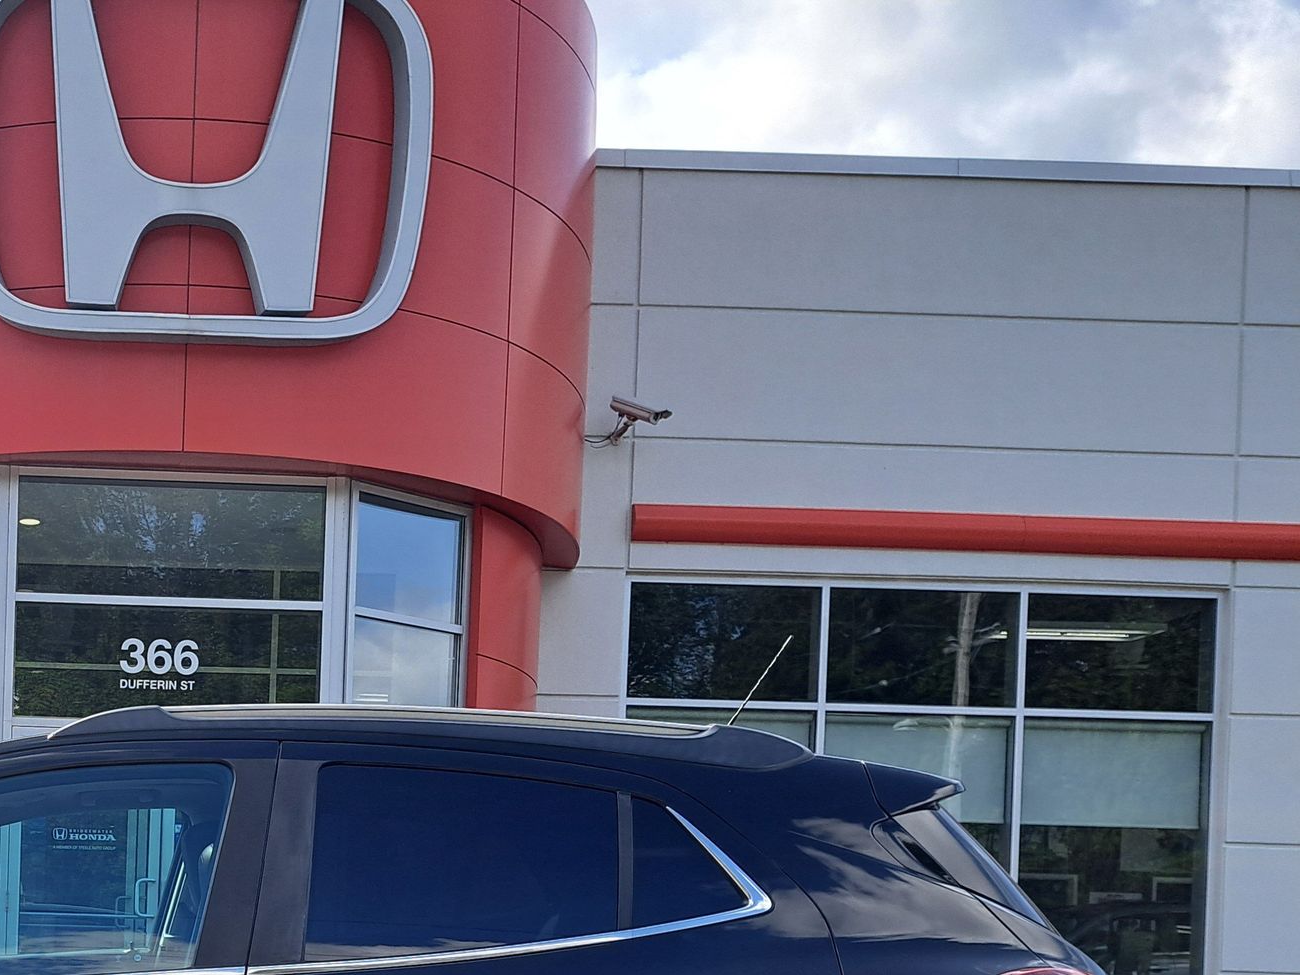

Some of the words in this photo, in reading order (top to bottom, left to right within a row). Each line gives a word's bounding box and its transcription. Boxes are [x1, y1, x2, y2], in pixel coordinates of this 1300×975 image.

[120, 637, 199, 675] 366
[120, 679, 177, 690] DUFFERIN
[180, 680, 195, 691] ST
[69, 833, 117, 841] HONDA
